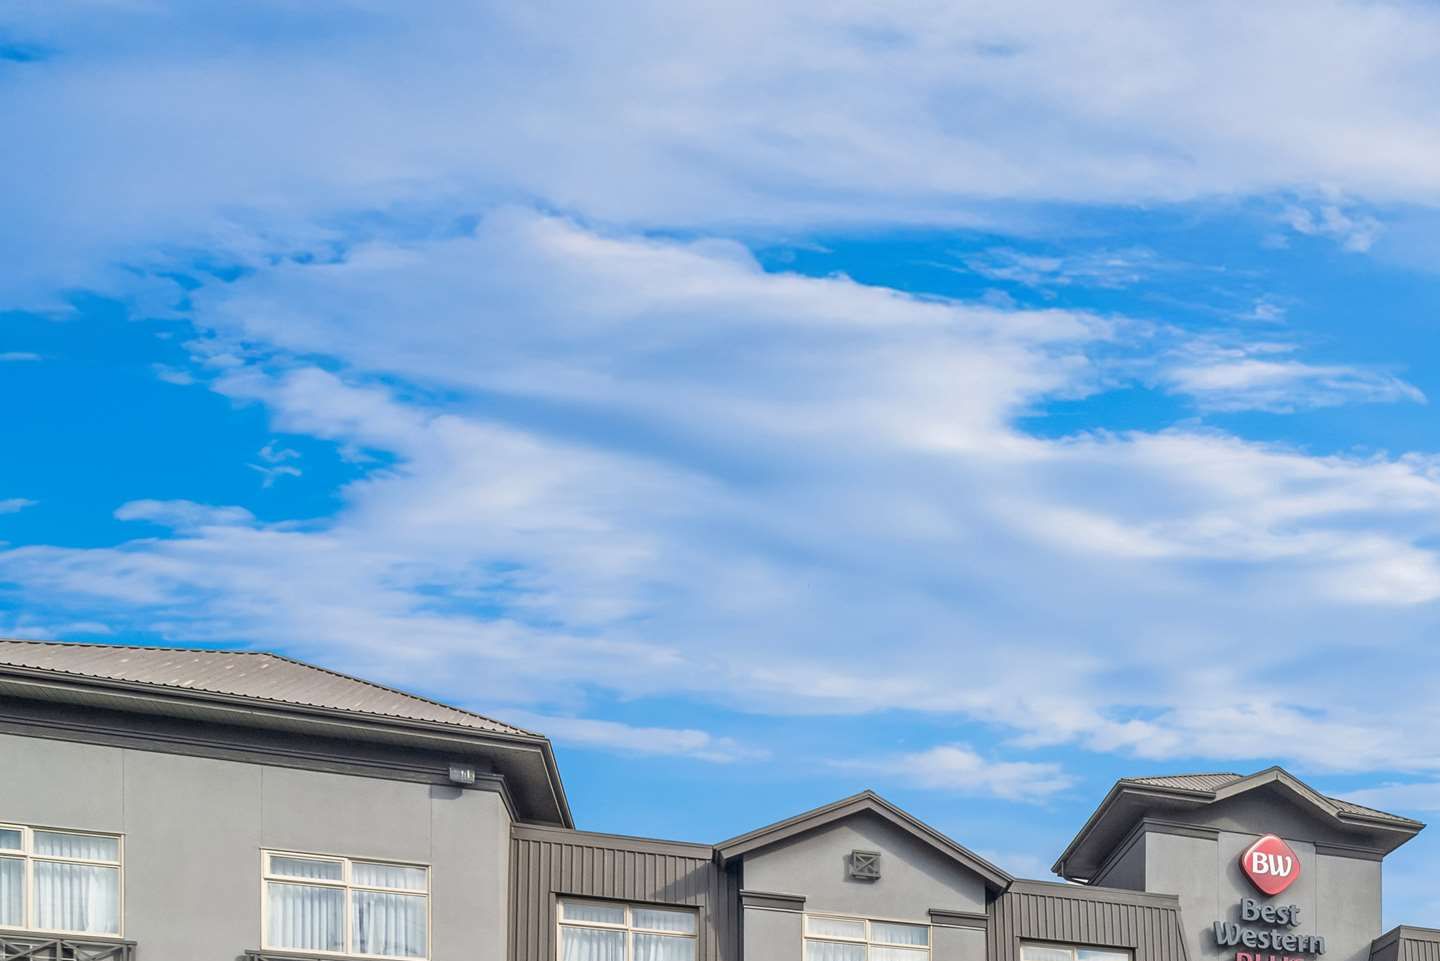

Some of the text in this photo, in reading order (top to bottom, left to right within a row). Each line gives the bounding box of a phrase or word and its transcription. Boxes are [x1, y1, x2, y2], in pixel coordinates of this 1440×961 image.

[1252, 851, 1292, 877] BW
[1241, 897, 1300, 927] Best
[1214, 920, 1328, 955] Western
